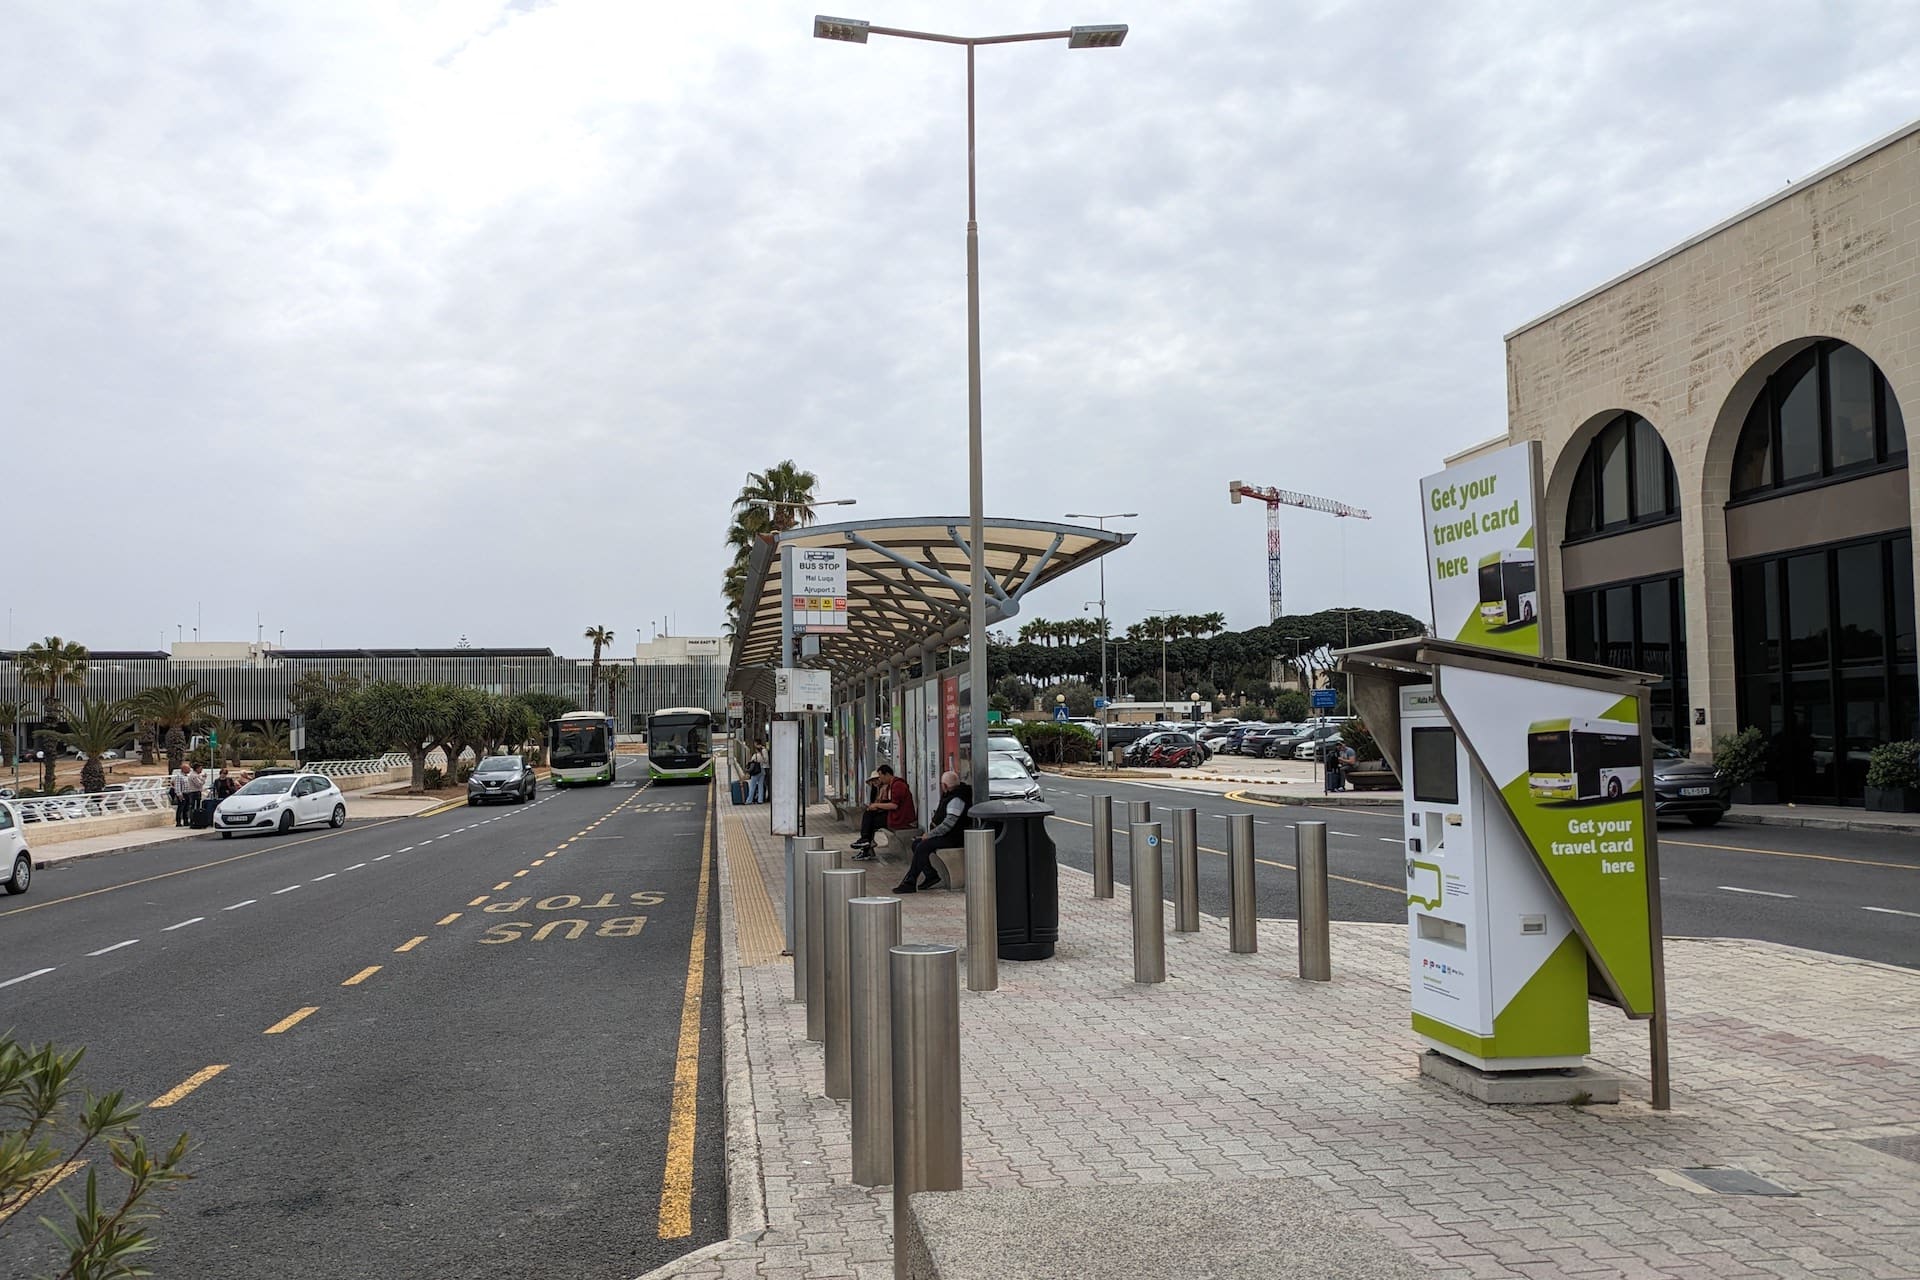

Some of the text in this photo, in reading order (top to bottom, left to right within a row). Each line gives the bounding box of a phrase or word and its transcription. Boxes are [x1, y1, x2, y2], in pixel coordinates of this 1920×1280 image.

[1430, 474, 1497, 512] Get your
[1433, 499, 1519, 547] travel card
[799, 562, 840, 570] BUS STOP
[1436, 556, 1469, 580] here
[1568, 819, 1632, 837] Get your
[1551, 837, 1634, 855] travel card
[1601, 859, 1635, 874] here
[482, 891, 668, 913] STOP
[477, 916, 648, 944] BUS
